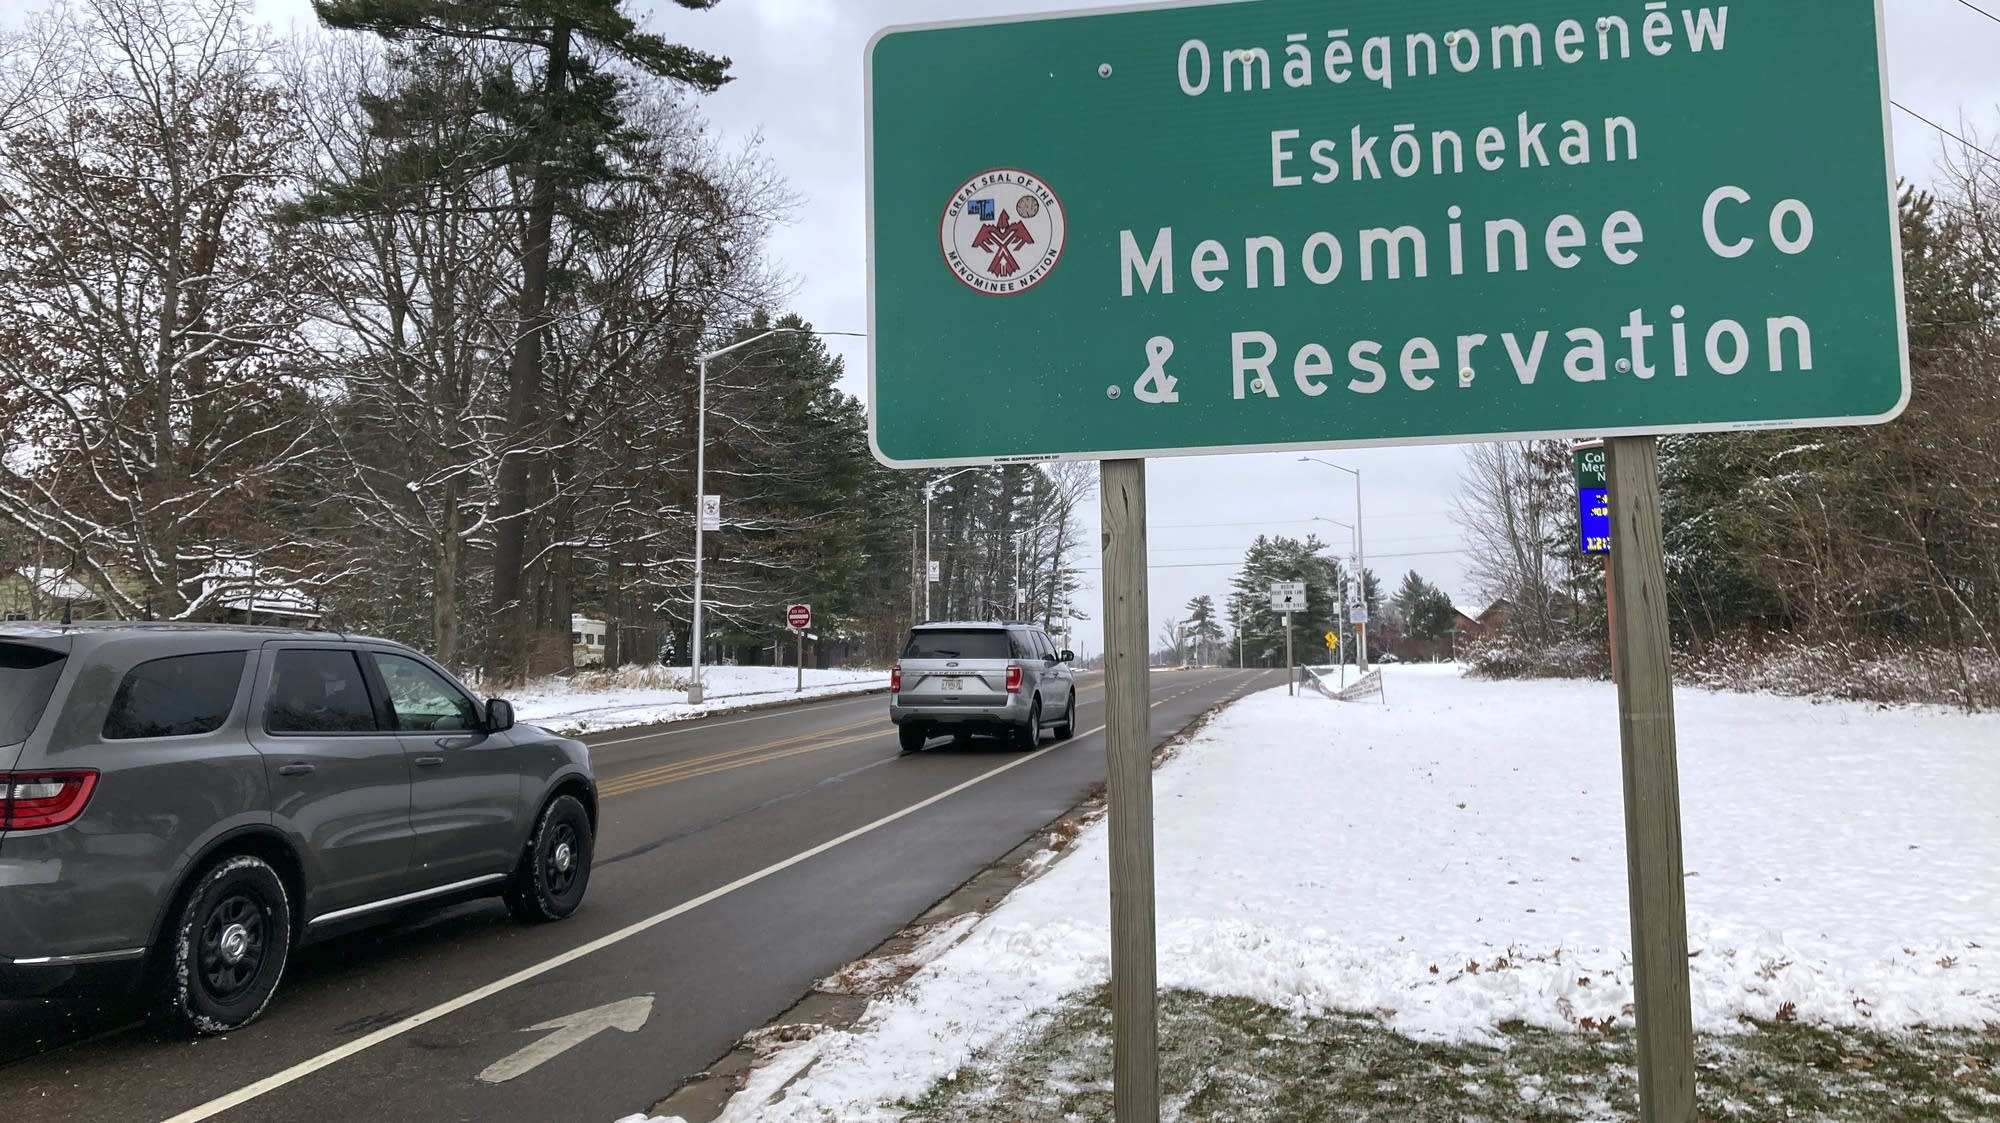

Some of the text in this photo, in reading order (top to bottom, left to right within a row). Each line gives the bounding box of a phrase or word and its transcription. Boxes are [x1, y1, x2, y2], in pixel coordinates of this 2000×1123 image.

[1178, 2, 1728, 96] Omāēqnomenēw
[1272, 111, 1638, 187] Eskōnekan
[949, 173, 1054, 217] GREAT SEAL OF THE
[948, 249, 1058, 292] MENOMINEE NATION
[1120, 186, 1814, 297] Menominee Co
[1134, 305, 1813, 404] & Reservation
